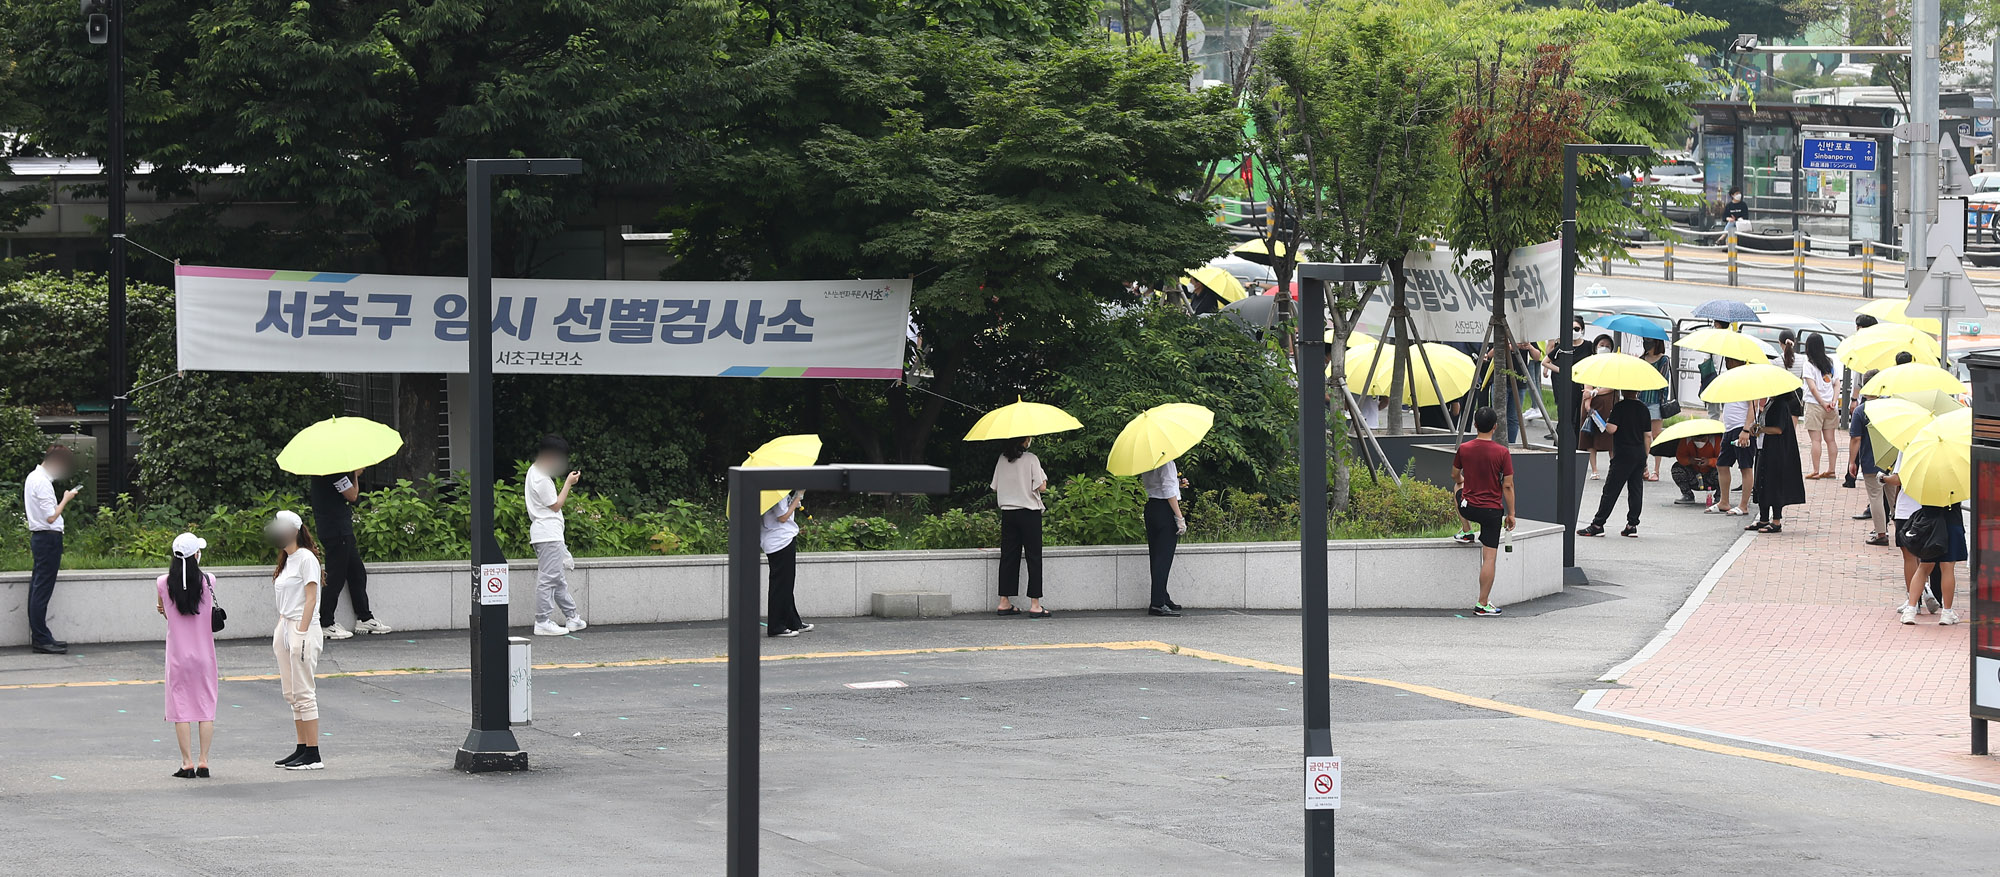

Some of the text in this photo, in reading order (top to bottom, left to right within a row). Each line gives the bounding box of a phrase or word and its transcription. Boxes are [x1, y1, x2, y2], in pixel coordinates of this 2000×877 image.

[1817, 141, 1852, 151] 신반포로
[1814, 152, 1854, 161] Sinbanpo-ro
[861, 288, 884, 301] 서초
[255, 290, 413, 341] 서초구
[553, 297, 815, 345] 선별검사소
[496, 351, 583, 367] 서초구보건소
[483, 567, 507, 576] 금연구역
[1309, 761, 1339, 771] 금연구역
